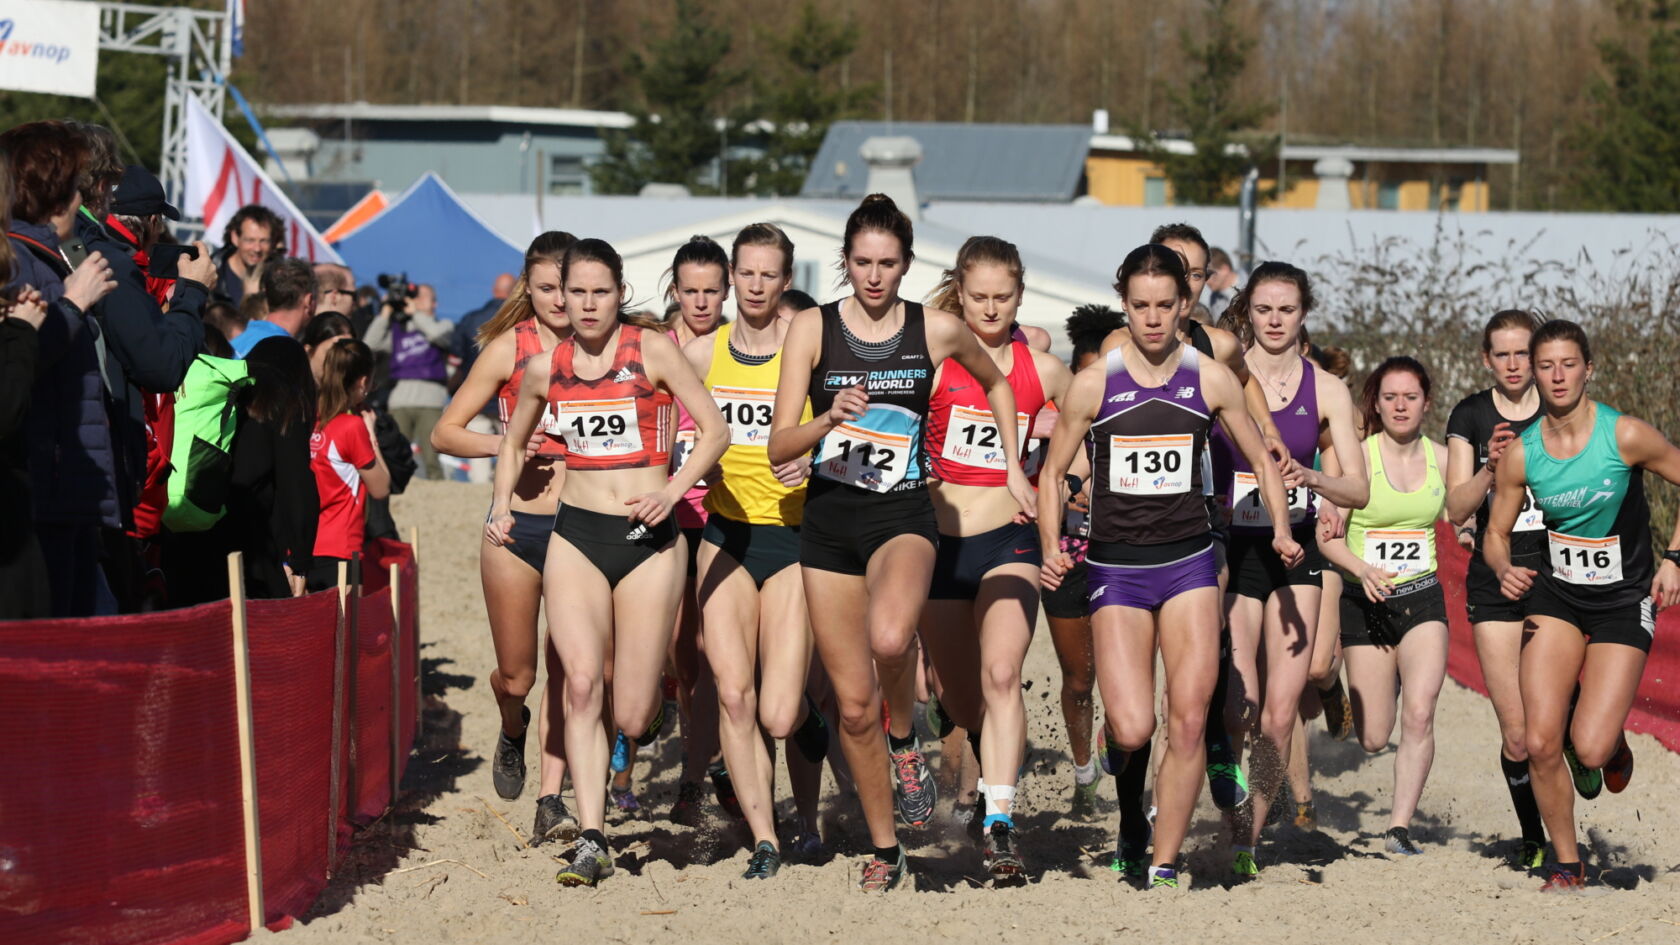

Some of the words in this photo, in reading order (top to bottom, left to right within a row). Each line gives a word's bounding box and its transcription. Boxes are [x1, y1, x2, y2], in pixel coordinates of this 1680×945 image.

[8, 41, 71, 64] avnop
[827, 375, 864, 386] RW
[868, 379, 914, 390] WORLD
[869, 369, 927, 380] RUNNERS
[720, 402, 773, 426] 103
[571, 414, 626, 438] 129
[962, 423, 1005, 449] 12
[837, 439, 896, 472] 112
[1124, 450, 1182, 474] 130
[1247, 487, 1298, 508] 18
[1375, 542, 1420, 560] 122
[1560, 547, 1611, 569] 116
[1396, 585, 1414, 595] new
